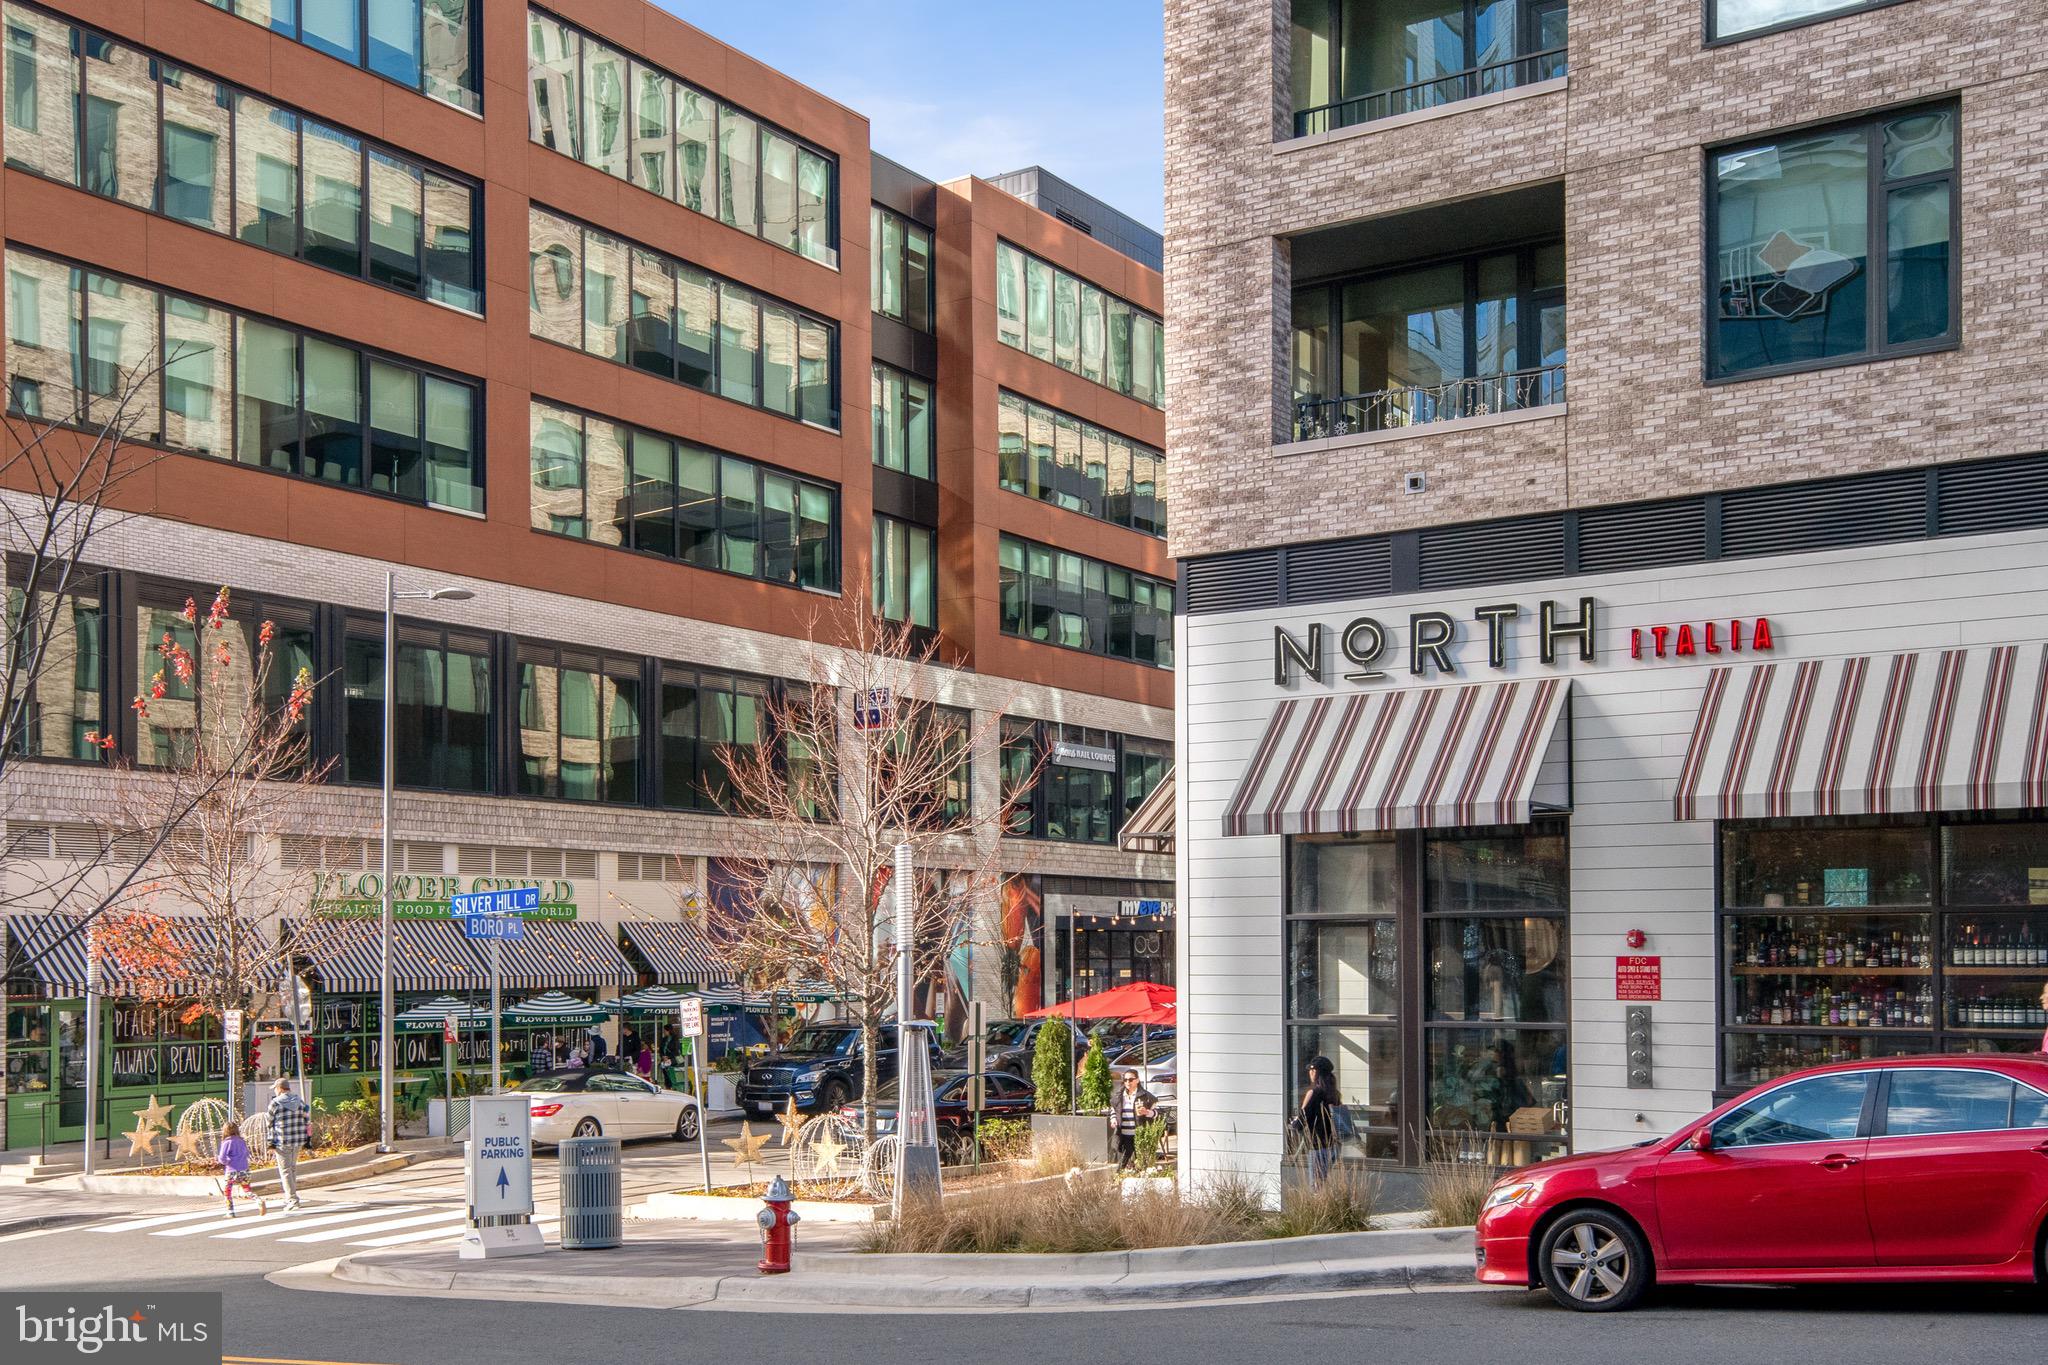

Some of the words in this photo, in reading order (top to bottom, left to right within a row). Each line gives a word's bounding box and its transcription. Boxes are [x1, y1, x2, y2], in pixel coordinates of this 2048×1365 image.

[1274, 596, 1598, 686] NORTH
[1631, 617, 1774, 660] ITALIA
[313, 871, 463, 901] FLOWER
[323, 904, 385, 914] HEALTH
[397, 905, 433, 914] FOOD
[531, 907, 573, 916] ORLD
[455, 897, 492, 915] SILVER
[496, 893, 521, 911] HILL
[525, 894, 537, 906] DR
[471, 918, 504, 936] BORO
[508, 922, 519, 934] PL
[1629, 957, 1647, 965] FDC
[313, 1004, 342, 1030] USIC
[351, 1003, 361, 1029] BE
[515, 1015, 558, 1023] FLOWER
[745, 1006, 769, 1014] FLOWER
[115, 1010, 155, 1038] PEACE
[164, 1011, 177, 1034] IS
[459, 1020, 487, 1028] HILD
[566, 1028, 591, 1050] HEALT
[113, 1048, 158, 1075] ALWAYS
[371, 1038, 401, 1068] PLY
[408, 1039, 427, 1063] ON
[484, 1136, 520, 1148] PUBLIC
[480, 1148, 524, 1160] PARKING
